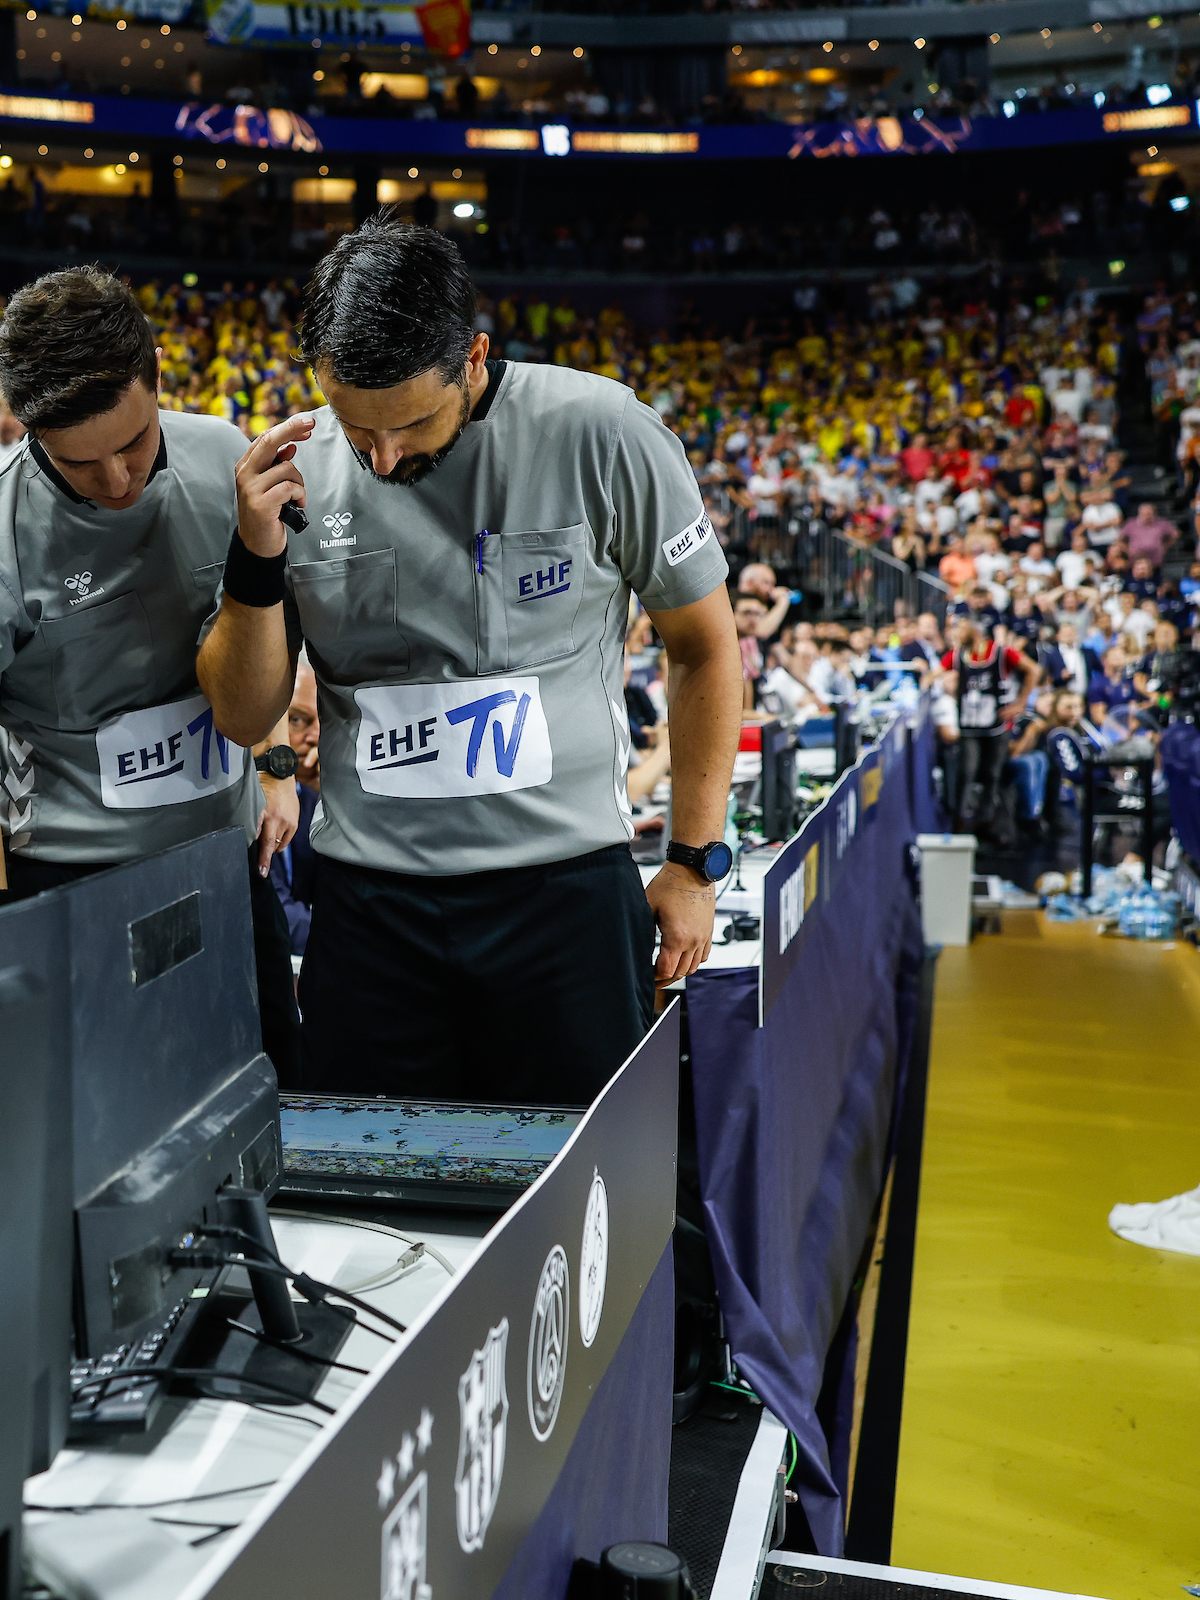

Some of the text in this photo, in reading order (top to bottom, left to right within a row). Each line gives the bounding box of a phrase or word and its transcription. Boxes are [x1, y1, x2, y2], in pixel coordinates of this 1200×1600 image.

[286, 4, 386, 38] 1965
[319, 534, 357, 549] hummel
[669, 531, 691, 558] EHF
[518, 559, 573, 597] EHF
[68, 586, 105, 606] hummel
[369, 689, 532, 779] EHF TV
[116, 730, 183, 778] EHF
